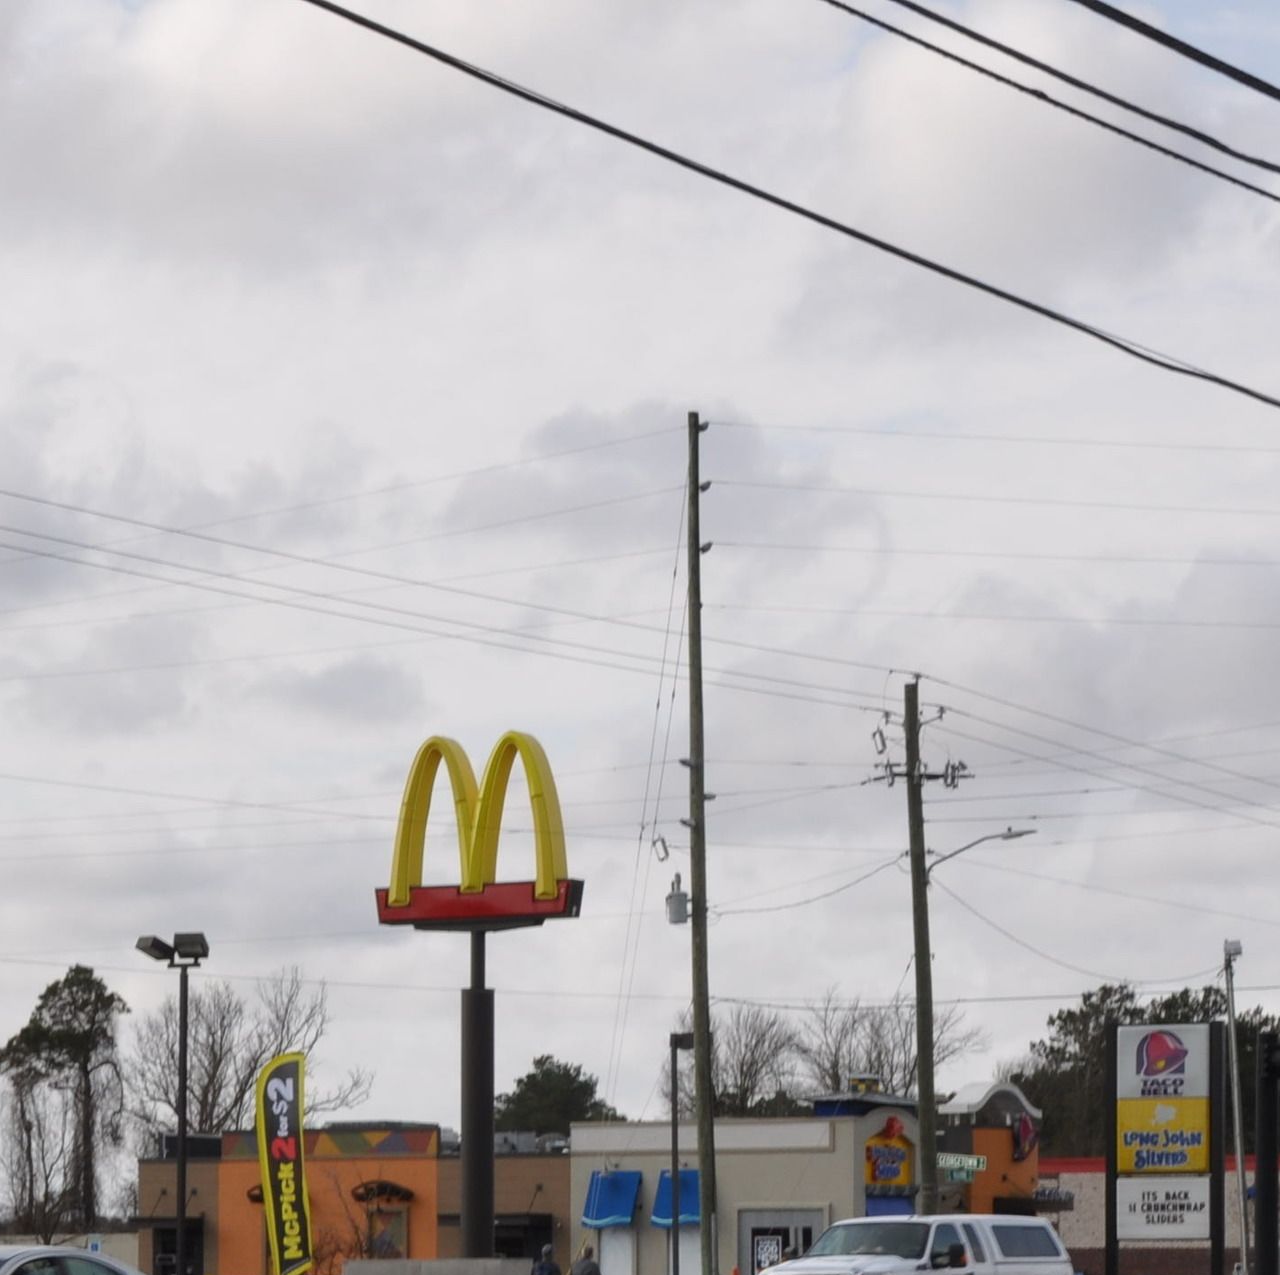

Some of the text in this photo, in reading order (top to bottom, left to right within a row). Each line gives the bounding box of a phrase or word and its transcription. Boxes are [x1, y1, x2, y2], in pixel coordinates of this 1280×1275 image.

[1140, 1079, 1185, 1088] TACO
[266, 1077, 294, 1115] $2
[271, 1136, 297, 1161] 2
[1142, 1190, 1190, 1201] ITS BACK
[277, 1162, 304, 1260] McPick
[1145, 1214, 1185, 1225] SLIDERS
